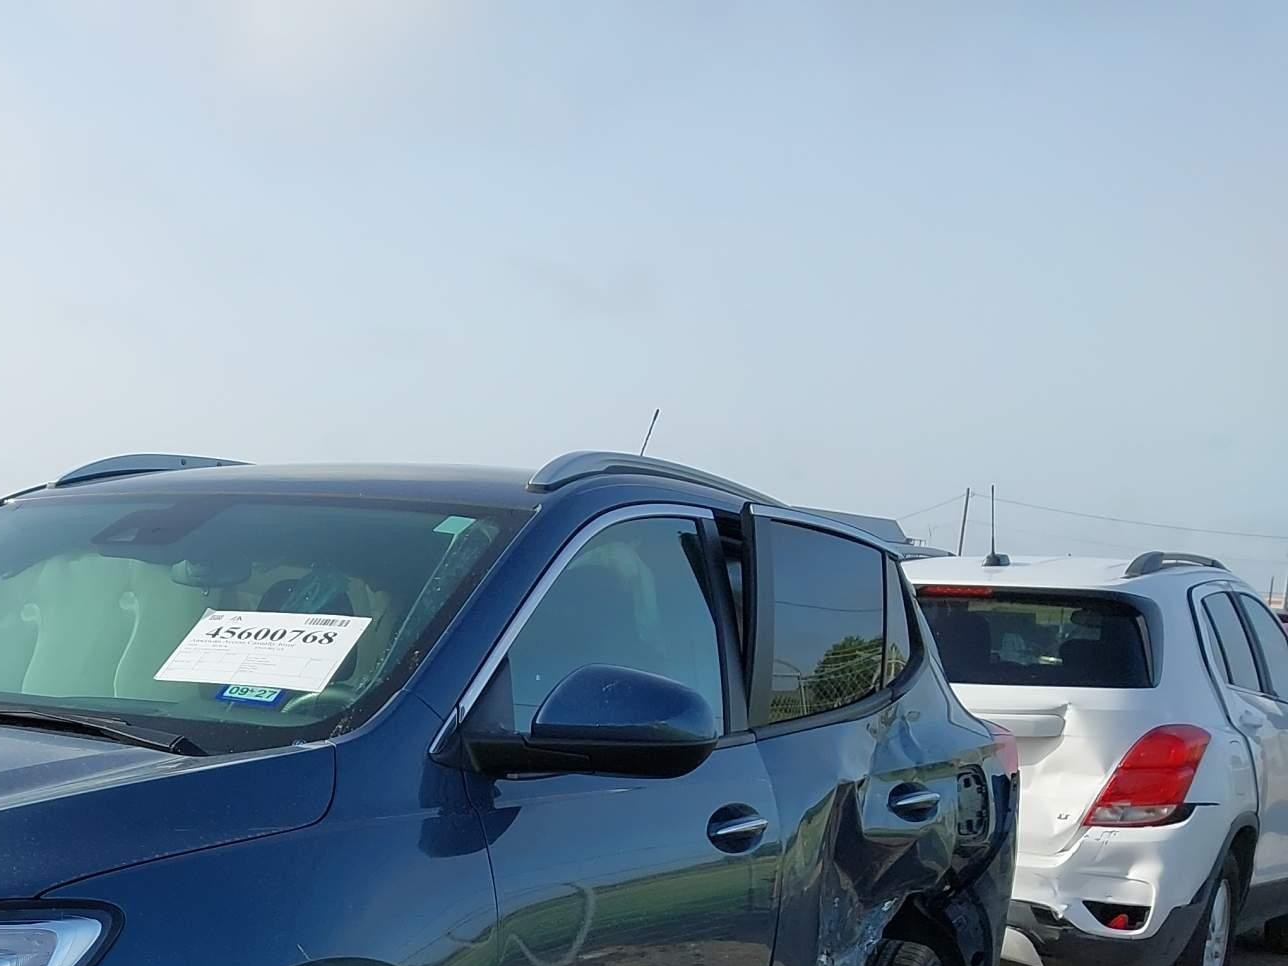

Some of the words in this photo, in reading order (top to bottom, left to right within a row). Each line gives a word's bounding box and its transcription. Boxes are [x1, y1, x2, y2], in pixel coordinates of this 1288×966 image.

[205, 625, 338, 646] 45600768
[228, 686, 249, 696] 09
[255, 689, 278, 699] 27
